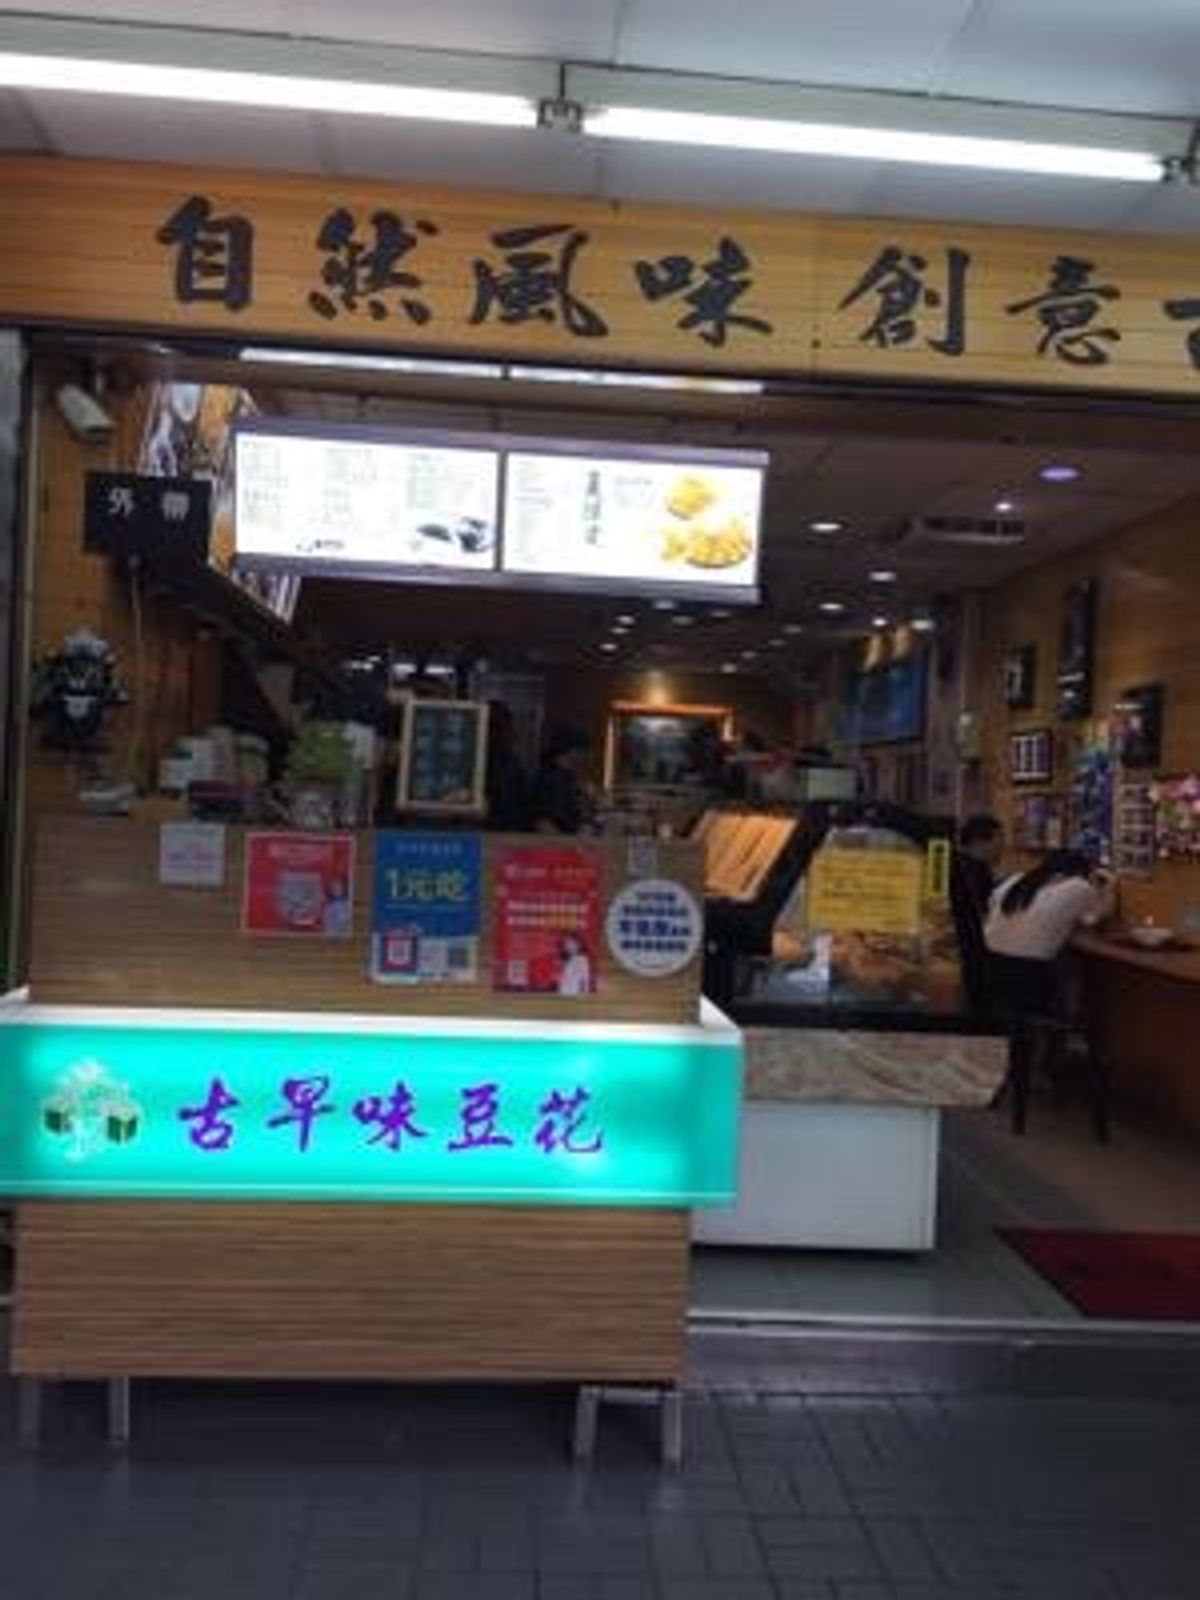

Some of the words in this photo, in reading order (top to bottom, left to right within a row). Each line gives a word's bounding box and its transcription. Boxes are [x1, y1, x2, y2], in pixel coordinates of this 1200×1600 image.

[177, 1073, 607, 1156] 古早味豆花
